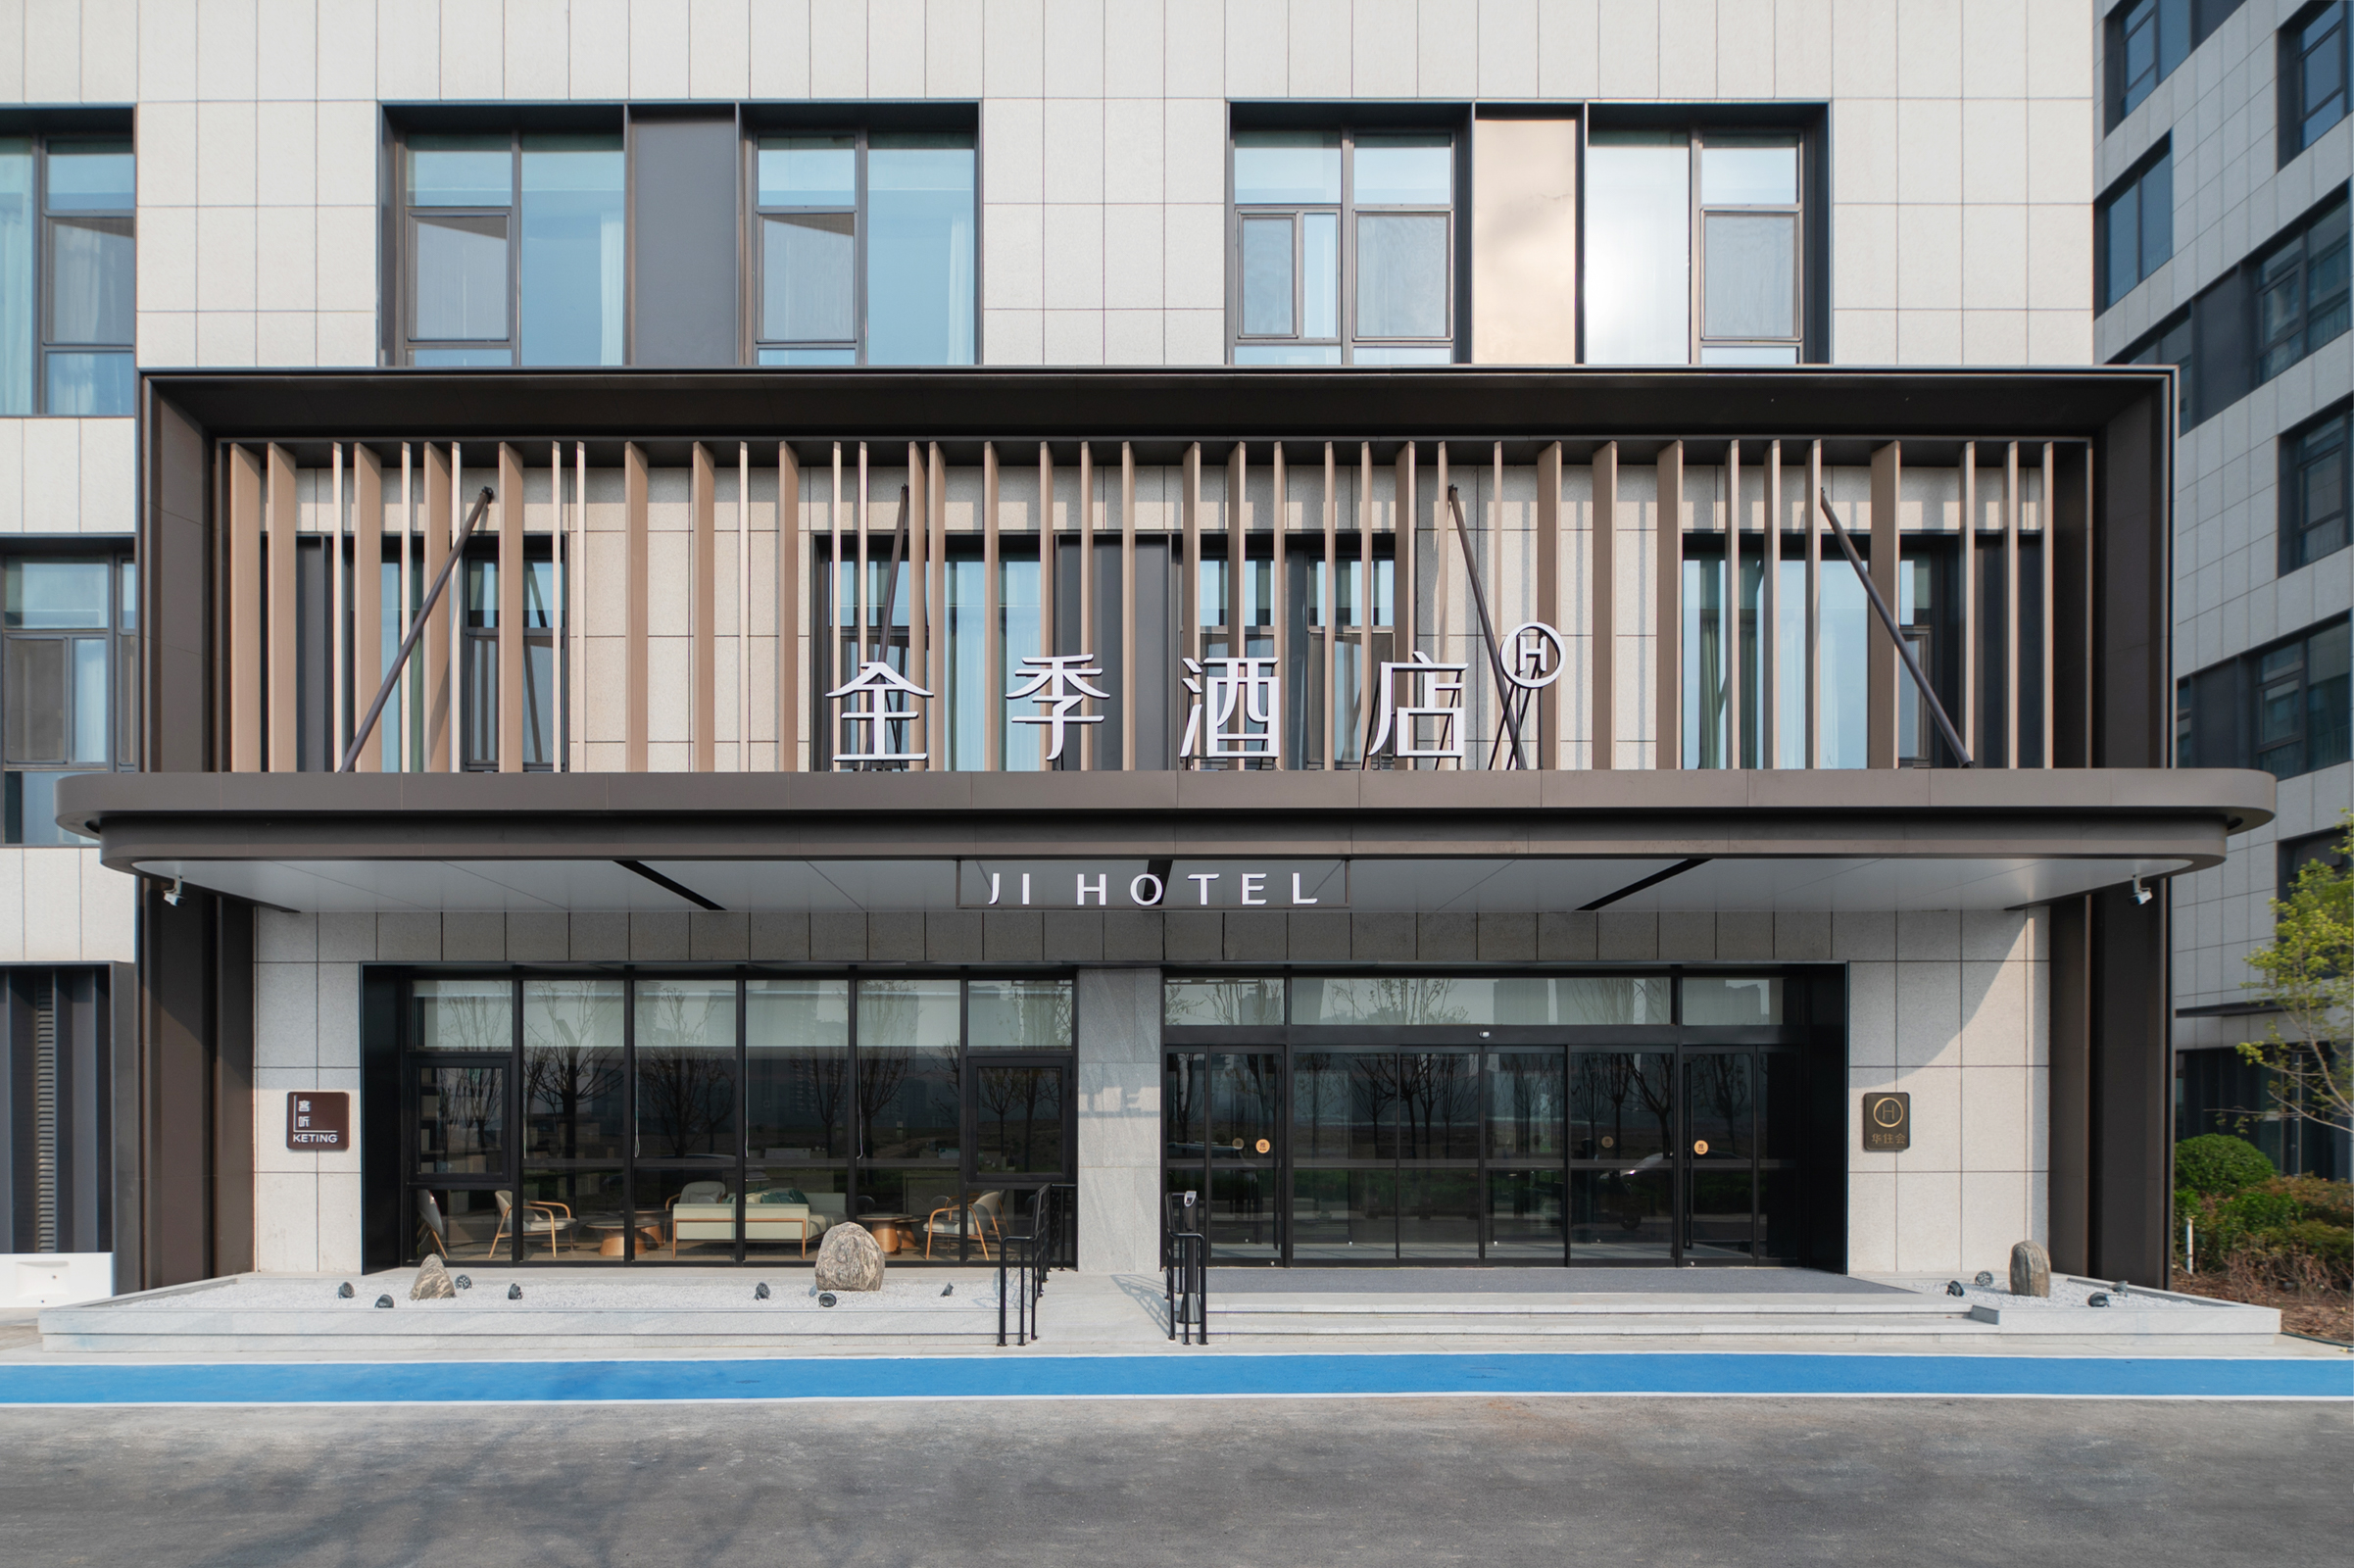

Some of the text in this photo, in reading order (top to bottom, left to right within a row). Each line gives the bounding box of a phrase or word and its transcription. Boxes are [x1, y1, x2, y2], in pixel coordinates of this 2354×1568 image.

[824, 652, 1469, 761] 全季酒店
[988, 872, 1318, 906] JI HOTEL
[292, 1133, 338, 1144] KETING
[1871, 1132, 1906, 1145] 华住会
